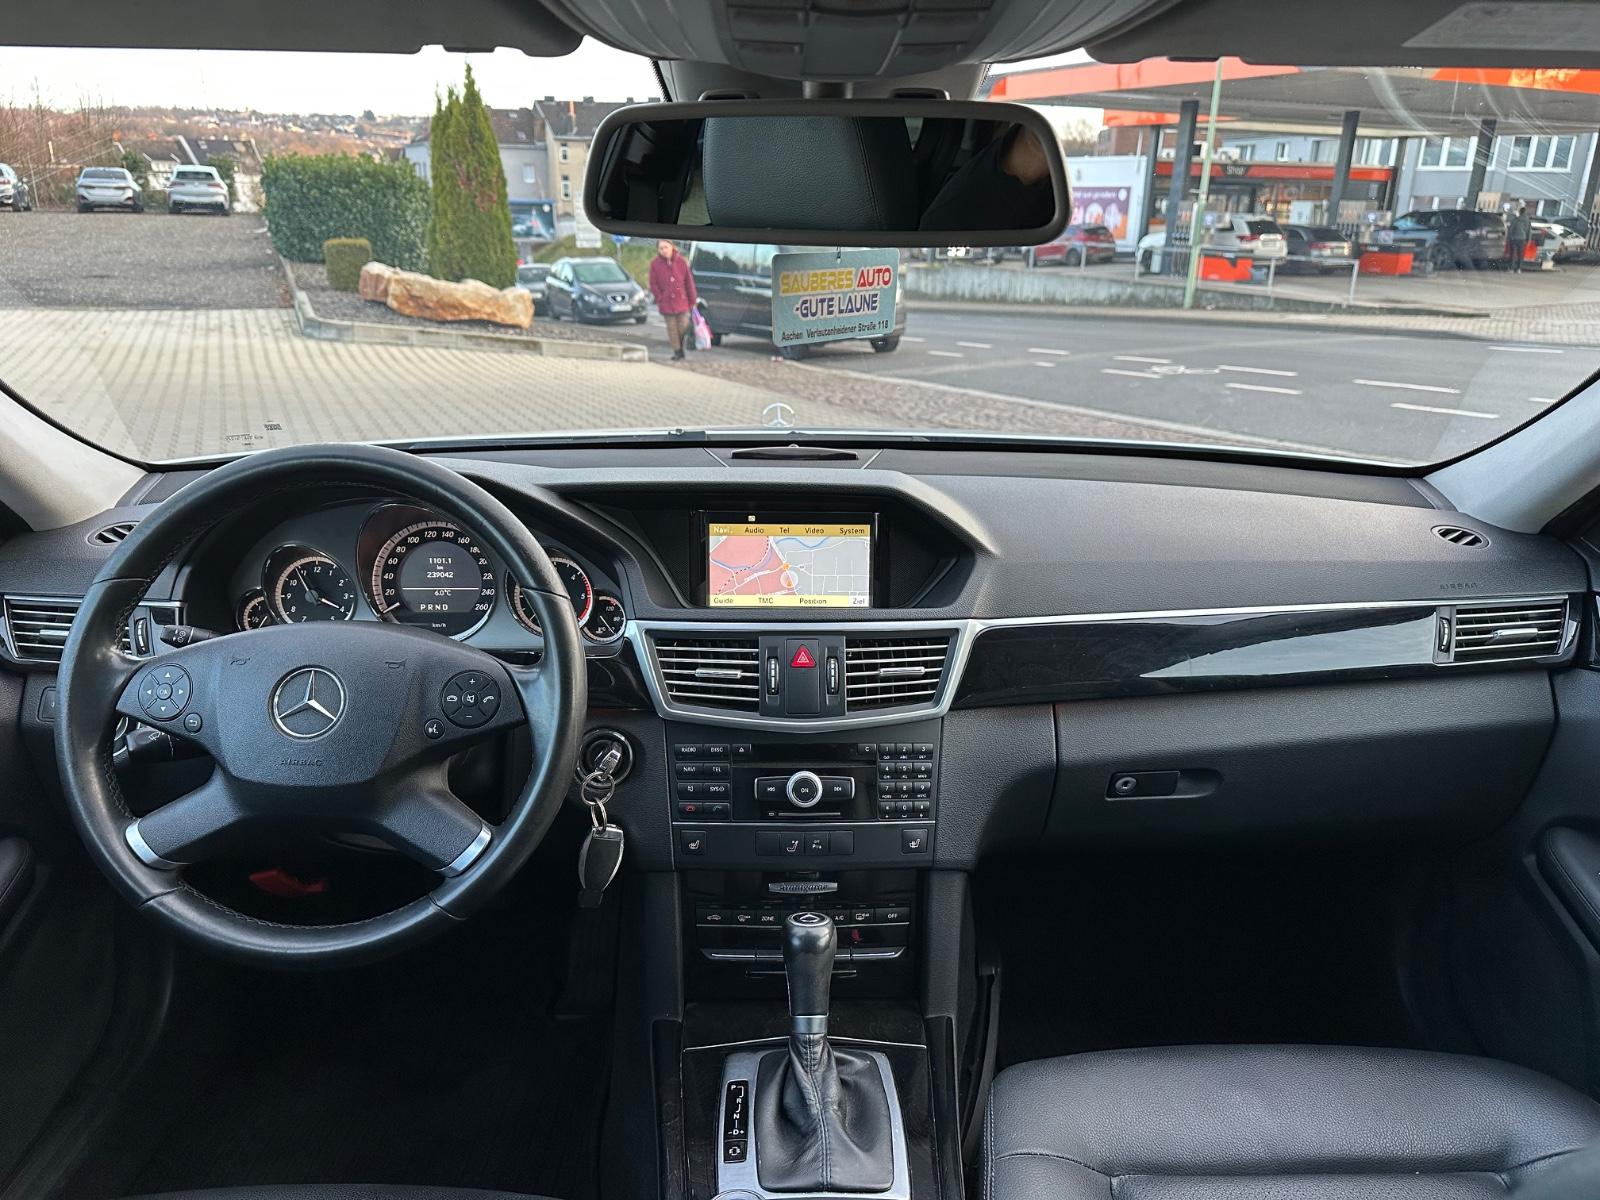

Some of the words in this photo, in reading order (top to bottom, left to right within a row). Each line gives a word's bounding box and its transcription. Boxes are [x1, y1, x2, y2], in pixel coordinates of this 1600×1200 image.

[780, 270, 853, 294] SAUBERES
[857, 267, 892, 288] AUTO
[838, 293, 878, 313] LAUNE
[744, 526, 765, 534] Audio
[805, 527, 825, 535] Video
[839, 527, 865, 536] System
[407, 536, 420, 544] 100
[290, 579, 298, 587] 10
[338, 579, 345, 587] 2
[713, 597, 734, 605] Guide
[758, 597, 774, 605] TMC
[799, 597, 827, 606] Position
[290, 605, 297, 613] 8
[475, 603, 489, 611] 260
